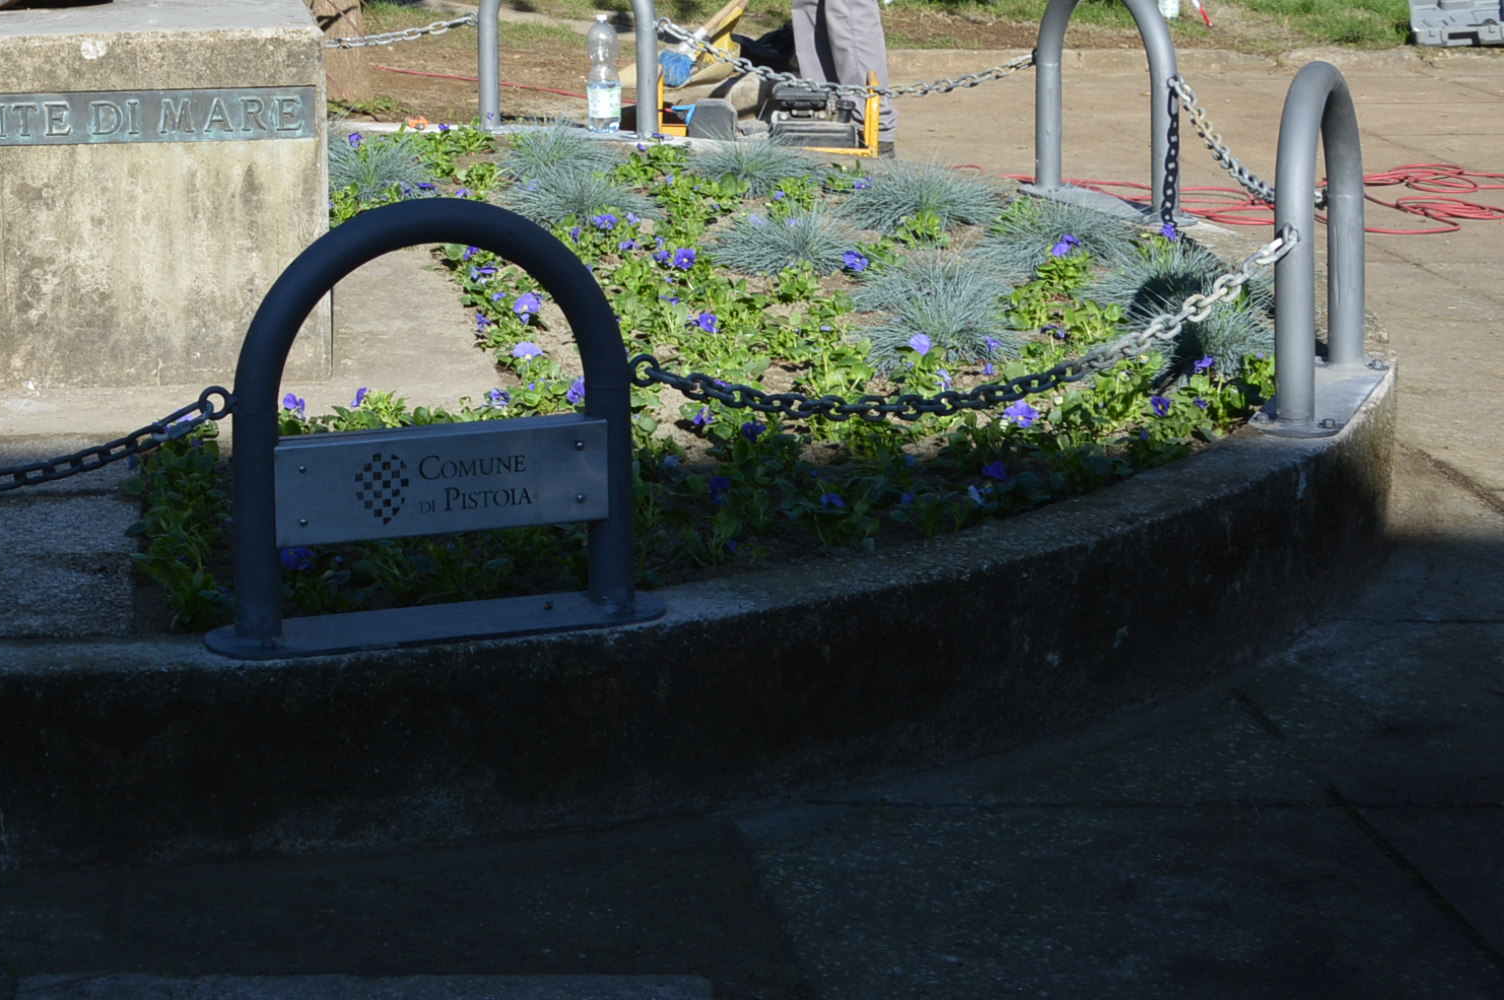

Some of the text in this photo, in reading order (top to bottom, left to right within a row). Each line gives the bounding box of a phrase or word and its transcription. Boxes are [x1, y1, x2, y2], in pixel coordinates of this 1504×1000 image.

[89, 99, 141, 137] DI
[158, 94, 305, 136] MARE
[418, 454, 528, 481] COMUNE
[444, 486, 533, 512] PISTOIA
